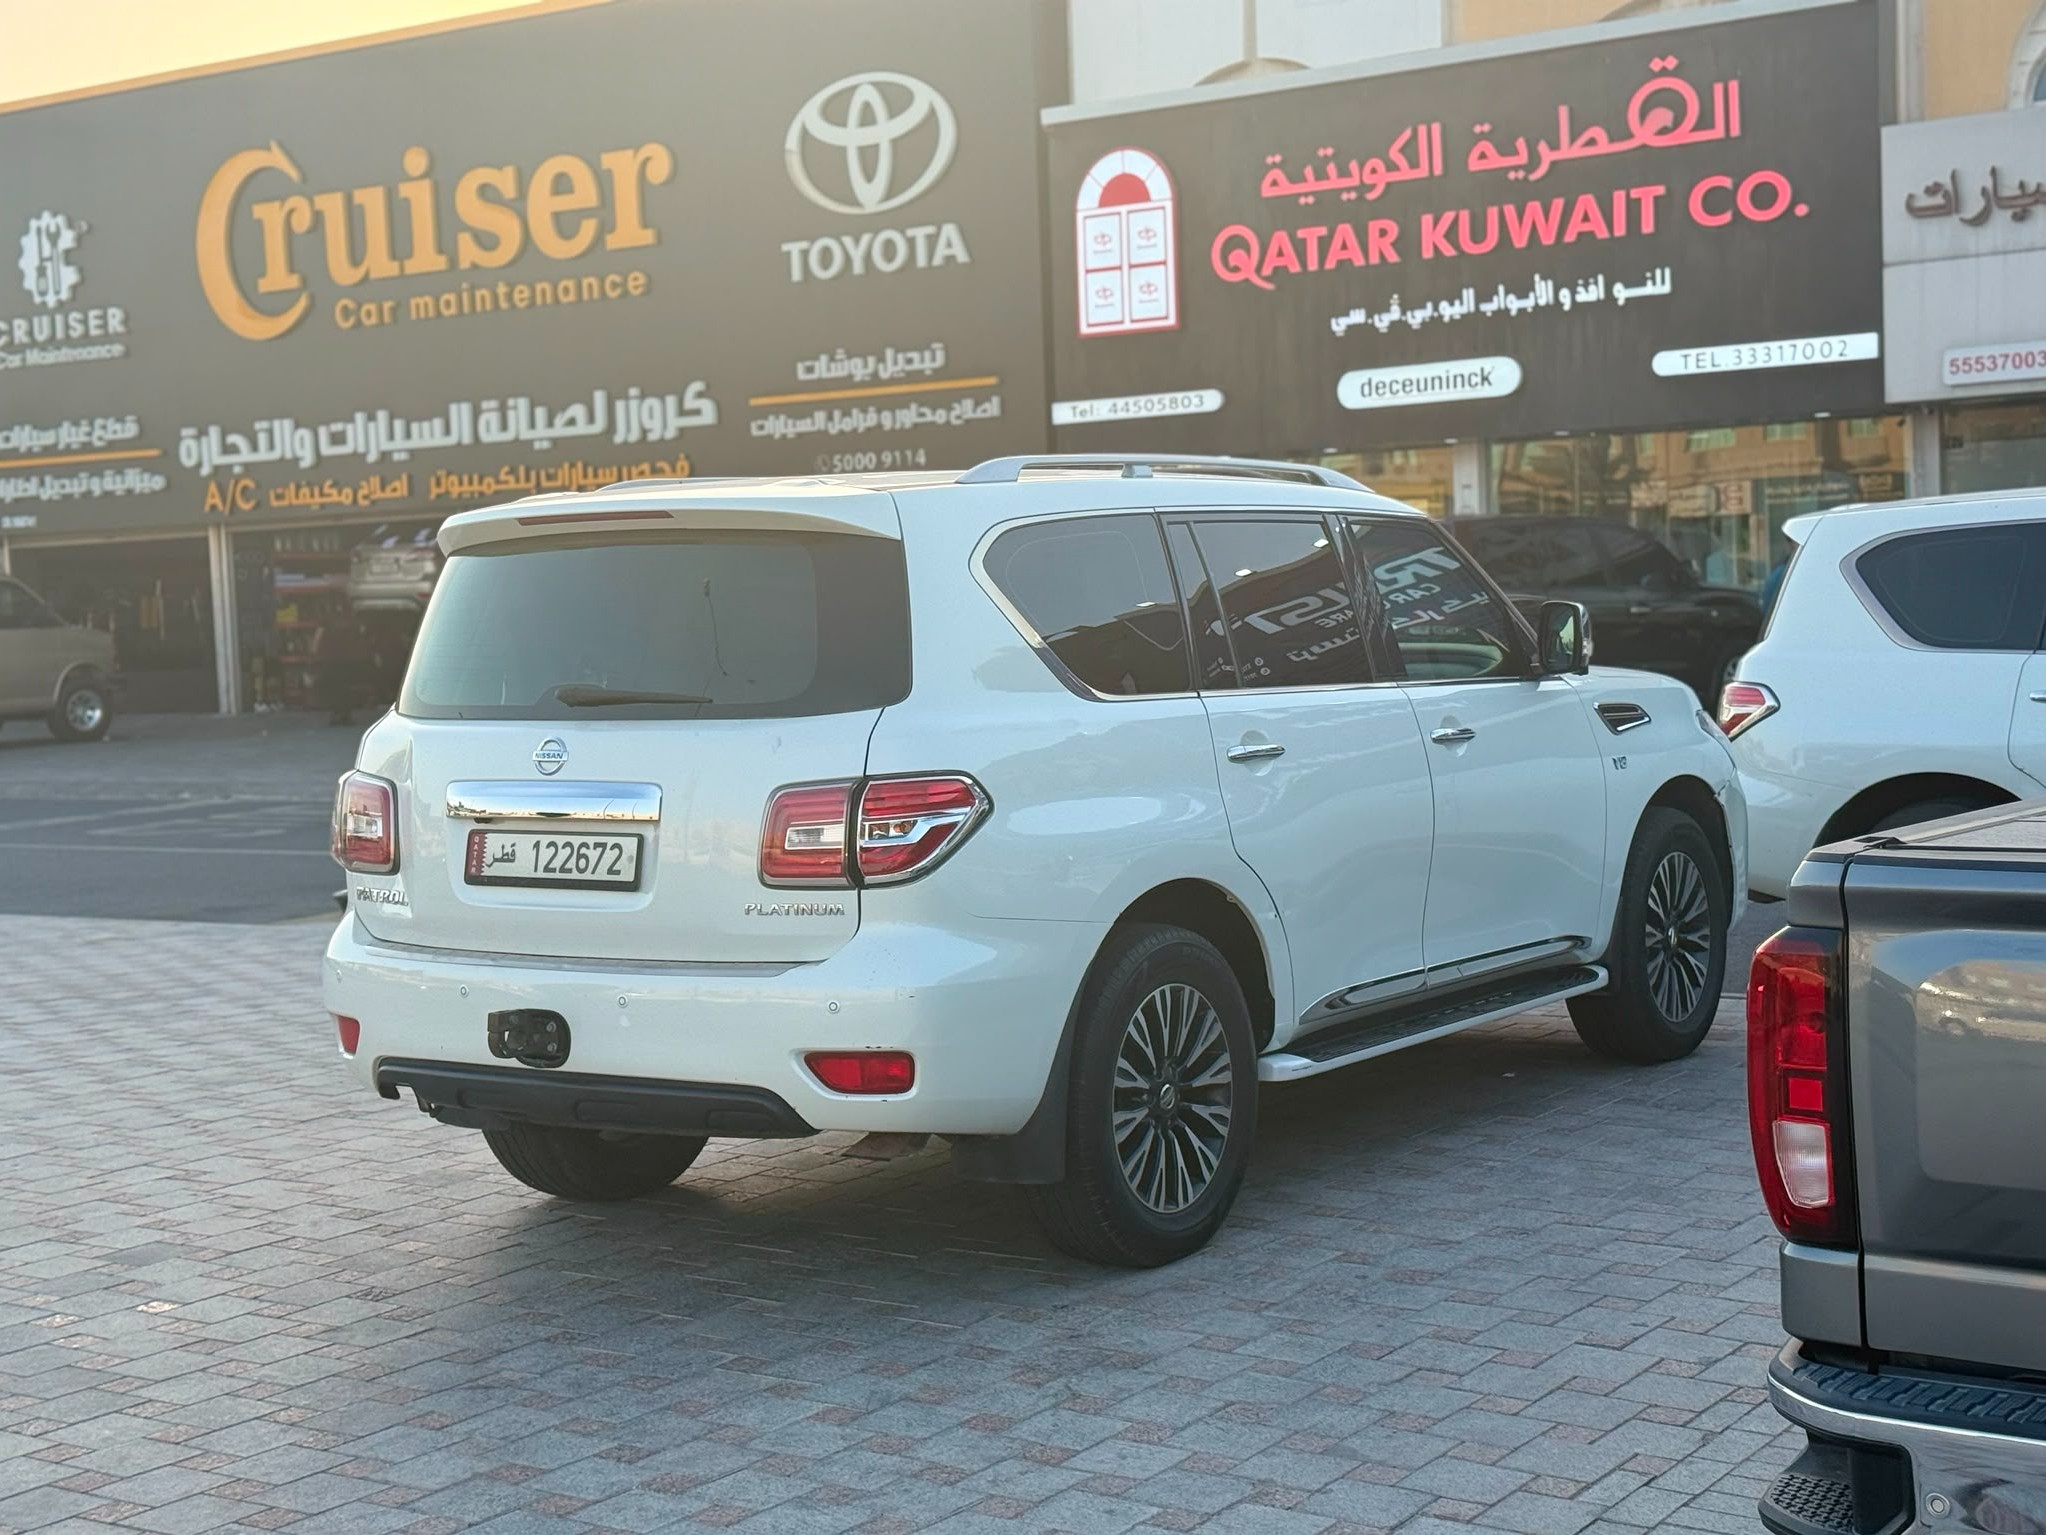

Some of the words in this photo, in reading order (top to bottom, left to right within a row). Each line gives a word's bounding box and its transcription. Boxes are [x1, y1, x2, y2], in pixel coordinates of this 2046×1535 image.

[1468, 55, 1741, 181] القطرية
[1260, 122, 1443, 204] الكويتية
[196, 141, 672, 341] Cruiser
[1210, 222, 1401, 290] QATAR
[1421, 185, 1666, 259] KUWAIT
[1688, 170, 1809, 226] CO.
[782, 223, 970, 282] TOYOTA
[334, 298, 396, 330] Car
[410, 271, 649, 320] maintenance
[878, 342, 946, 379] تبديل
[1360, 366, 1493, 398] deceuninck
[478, 390, 608, 450] لصيانة
[613, 380, 719, 444] كروزر
[1107, 394, 1205, 415] 44505803
[317, 402, 474, 463] السيارات
[751, 410, 827, 440] السيارات
[833, 453, 876, 472] 5000
[881, 448, 926, 467] 9114
[204, 477, 257, 516] A/C
[535, 752, 564, 760] NISSAN
[486, 843, 516, 868] قطر
[532, 840, 623, 876] 122672
[356, 886, 409, 907] PATROL
[744, 902, 846, 917] PLATINUM
